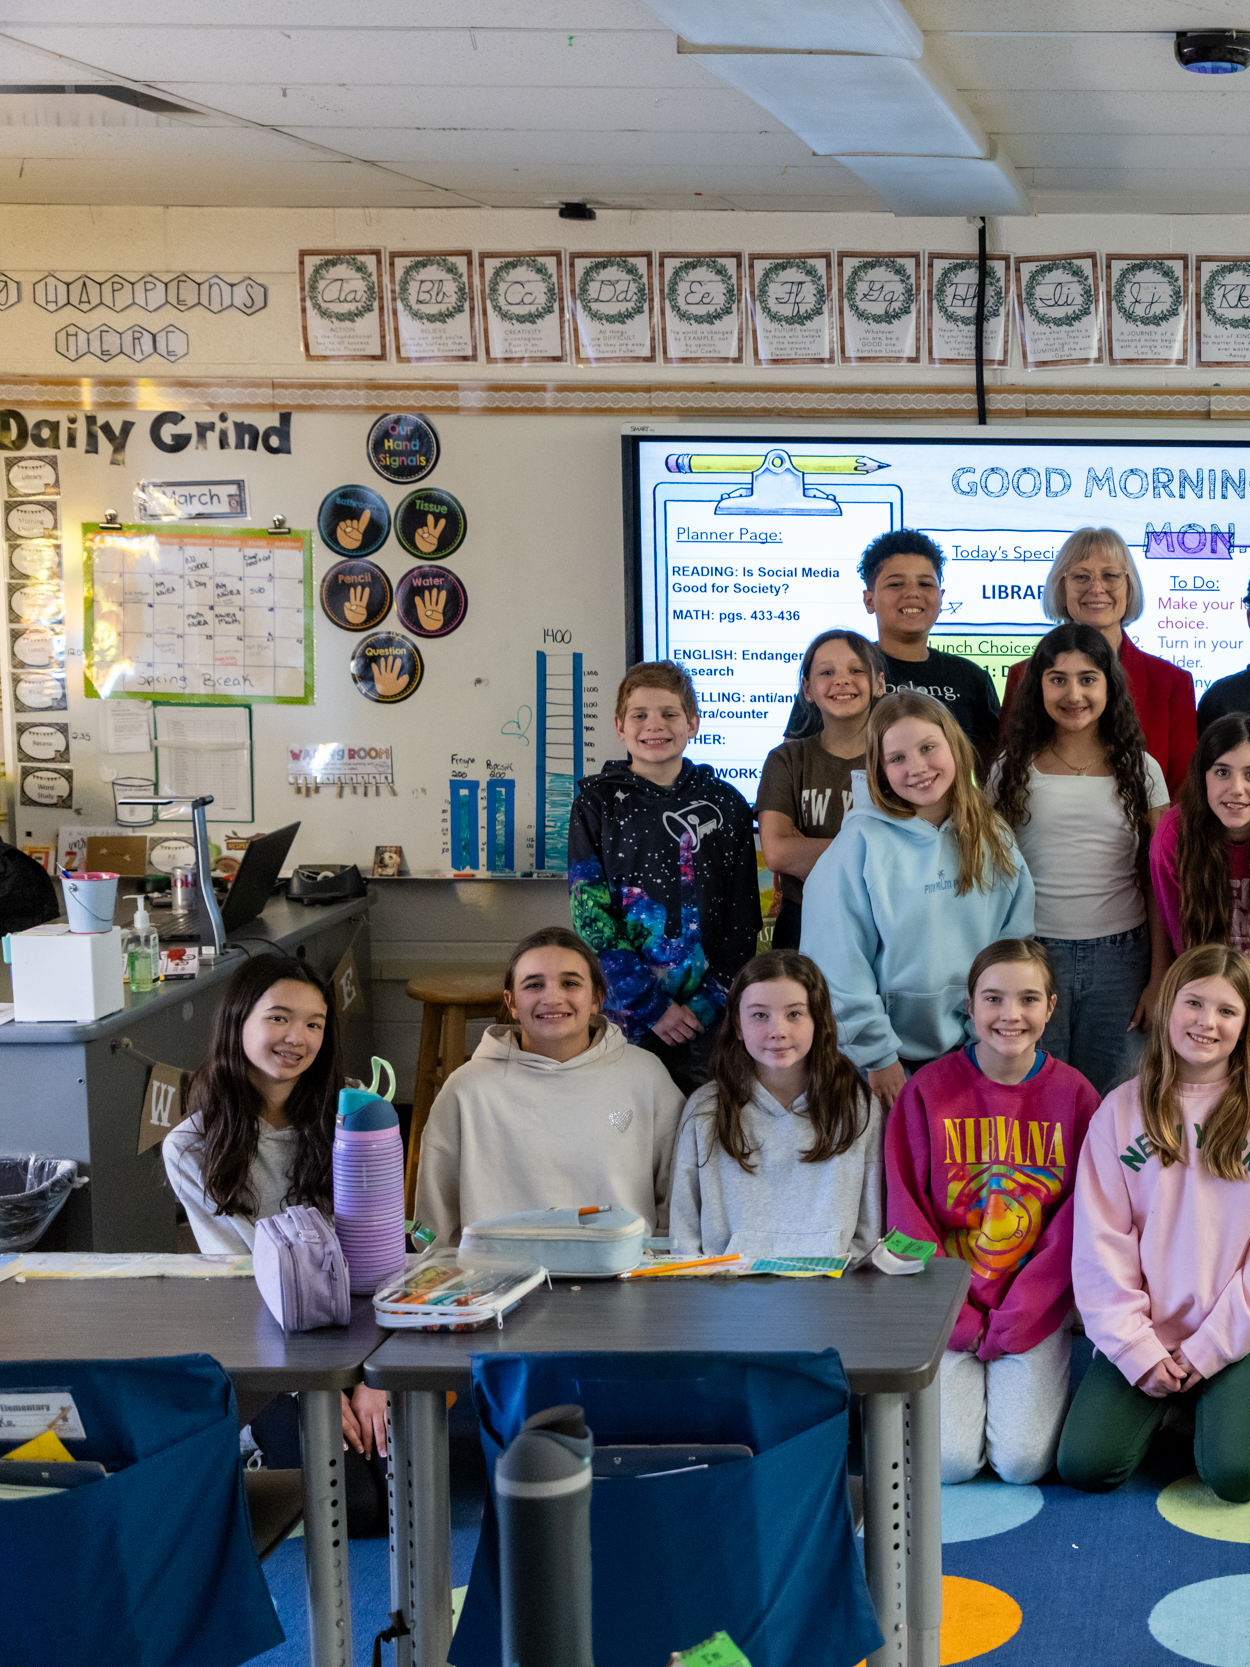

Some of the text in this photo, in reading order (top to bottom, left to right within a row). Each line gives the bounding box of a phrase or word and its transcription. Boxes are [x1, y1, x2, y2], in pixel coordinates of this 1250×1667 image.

[45, 280, 254, 309] HAPPENS
[321, 278, 365, 303] Aa
[415, 279, 452, 304] Bb
[504, 281, 537, 305] Cc
[589, 280, 636, 303] Dd
[685, 281, 715, 305] Ee
[775, 281, 806, 317] Ff
[860, 280, 900, 314] Gg
[1039, 282, 1076, 307] Ii
[1128, 282, 1161, 315] Jj
[66, 330, 178, 356] HERE
[0, 409, 292, 467] Daily Grind
[389, 424, 413, 435] Our
[384, 439, 419, 450] Hand
[379, 454, 426, 468] Signals
[952, 466, 1071, 498] GOOD
[162, 489, 221, 507] March
[336, 496, 377, 511] Bathroom
[415, 500, 448, 514] Tissue
[676, 527, 783, 544] Planner Page:
[1143, 522, 1247, 554] MON.
[952, 545, 1008, 562] Today's
[338, 573, 371, 583] Pencil
[672, 566, 840, 578] READING: Is Social Media
[412, 577, 445, 587] Water
[672, 583, 789, 596] Good for Society?
[1170, 576, 1220, 588] To Do:
[1158, 597, 1235, 613] Make your
[673, 610, 800, 624] MATH: pgs. 433-436
[1157, 616, 1208, 629] choice.
[543, 628, 572, 644] 1400
[1132, 636, 1243, 652] 2. Turn in your
[366, 647, 406, 656] Question
[673, 649, 737, 660] ENGLISH:
[138, 673, 255, 690] Spring Break
[348, 747, 389, 760] ROOM
[37, 792, 54, 800] Study
[149, 1080, 176, 1128] W
[943, 1116, 1067, 1166] NIRVANA
